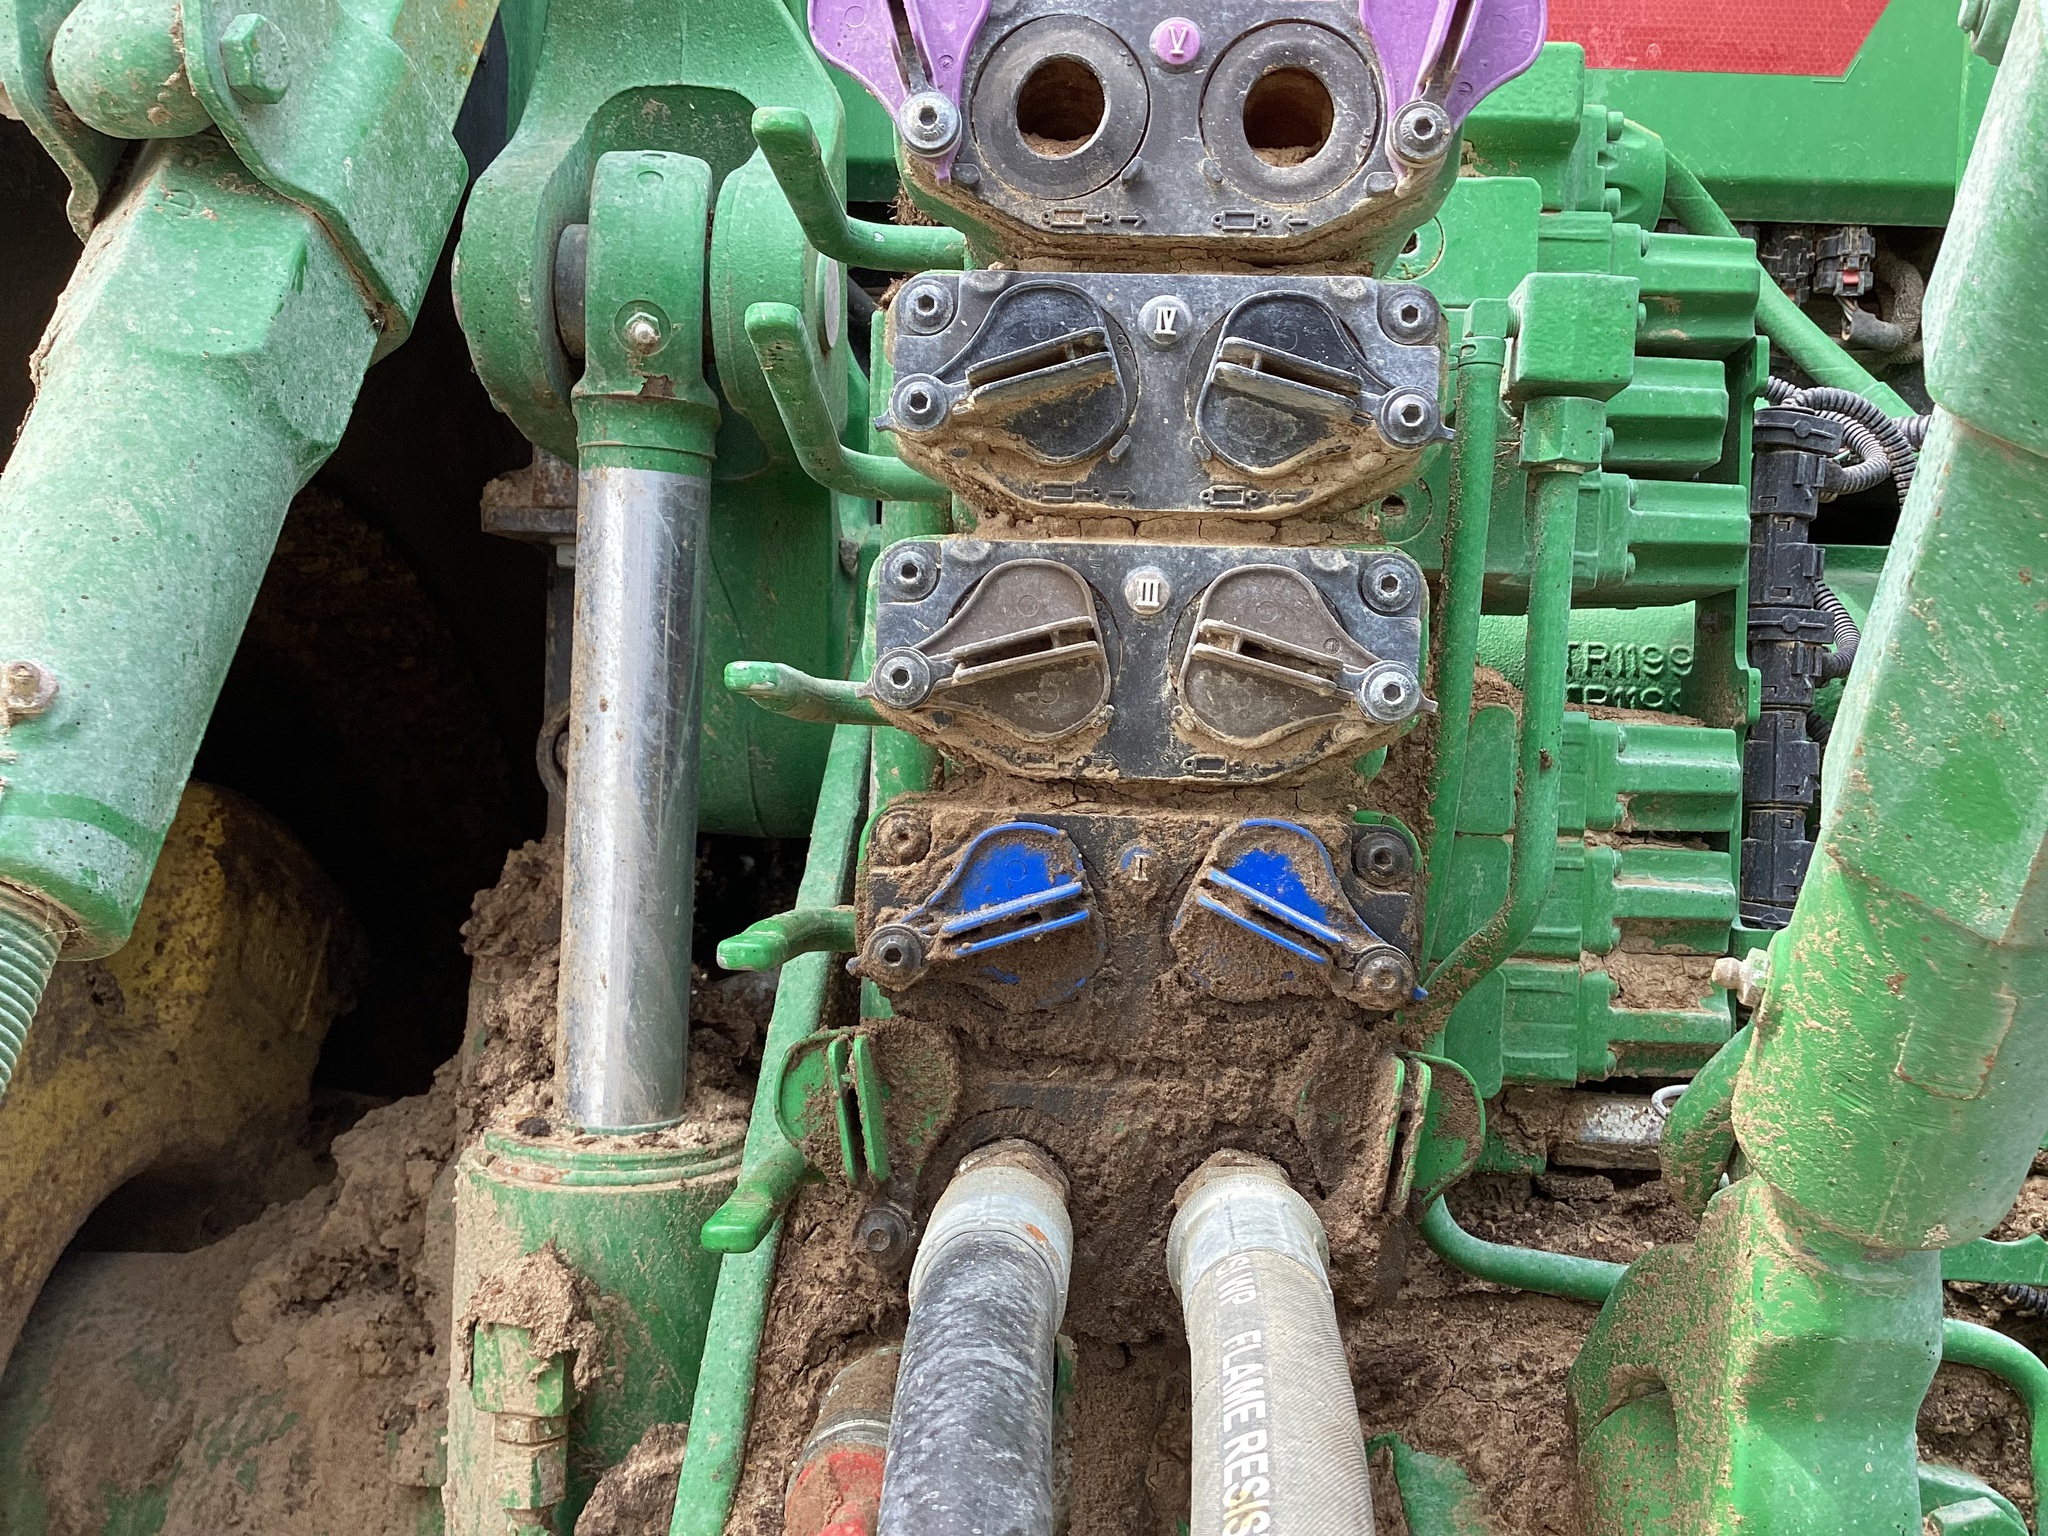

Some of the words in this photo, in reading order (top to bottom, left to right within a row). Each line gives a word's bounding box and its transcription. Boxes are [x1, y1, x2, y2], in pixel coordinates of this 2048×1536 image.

[1167, 25, 1189, 54] V
[1153, 306, 1178, 335] IV
[1134, 578, 1161, 607] III
[1222, 1329, 1267, 1433] FLAME
[1222, 1428, 1271, 1536] RESIS
